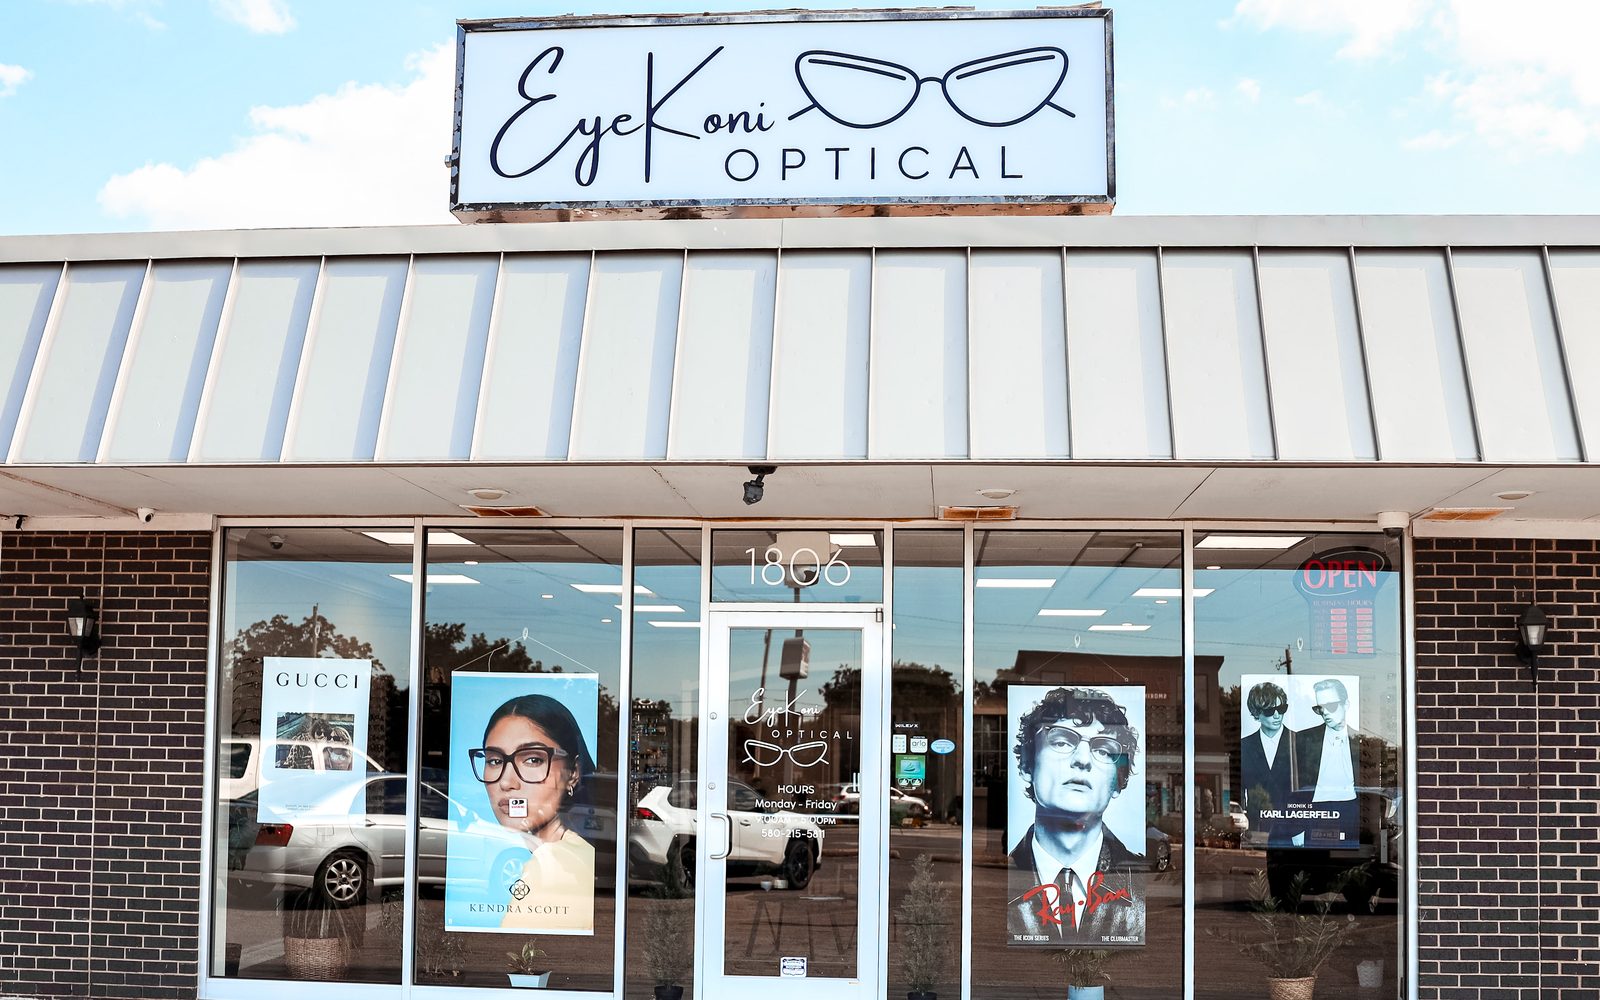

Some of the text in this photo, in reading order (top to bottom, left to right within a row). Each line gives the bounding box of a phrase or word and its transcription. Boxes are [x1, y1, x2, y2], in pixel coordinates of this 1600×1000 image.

[489, 45, 775, 187] EyeKoni
[724, 145, 1023, 183] OPTICAL
[745, 547, 851, 586] 1806
[1303, 559, 1377, 589] OPEN
[276, 672, 358, 689] GUCCI
[744, 687, 820, 728] EyeKoni
[771, 729, 853, 740] OPTICAL
[777, 784, 815, 794] HOURS
[755, 799, 796, 810] Monday
[805, 799, 837, 811] Friday
[1260, 810, 1340, 819] KARL LAGERFELD
[761, 829, 825, 839] 580-215-5811
[469, 903, 570, 915] KENDRA SCOTT
